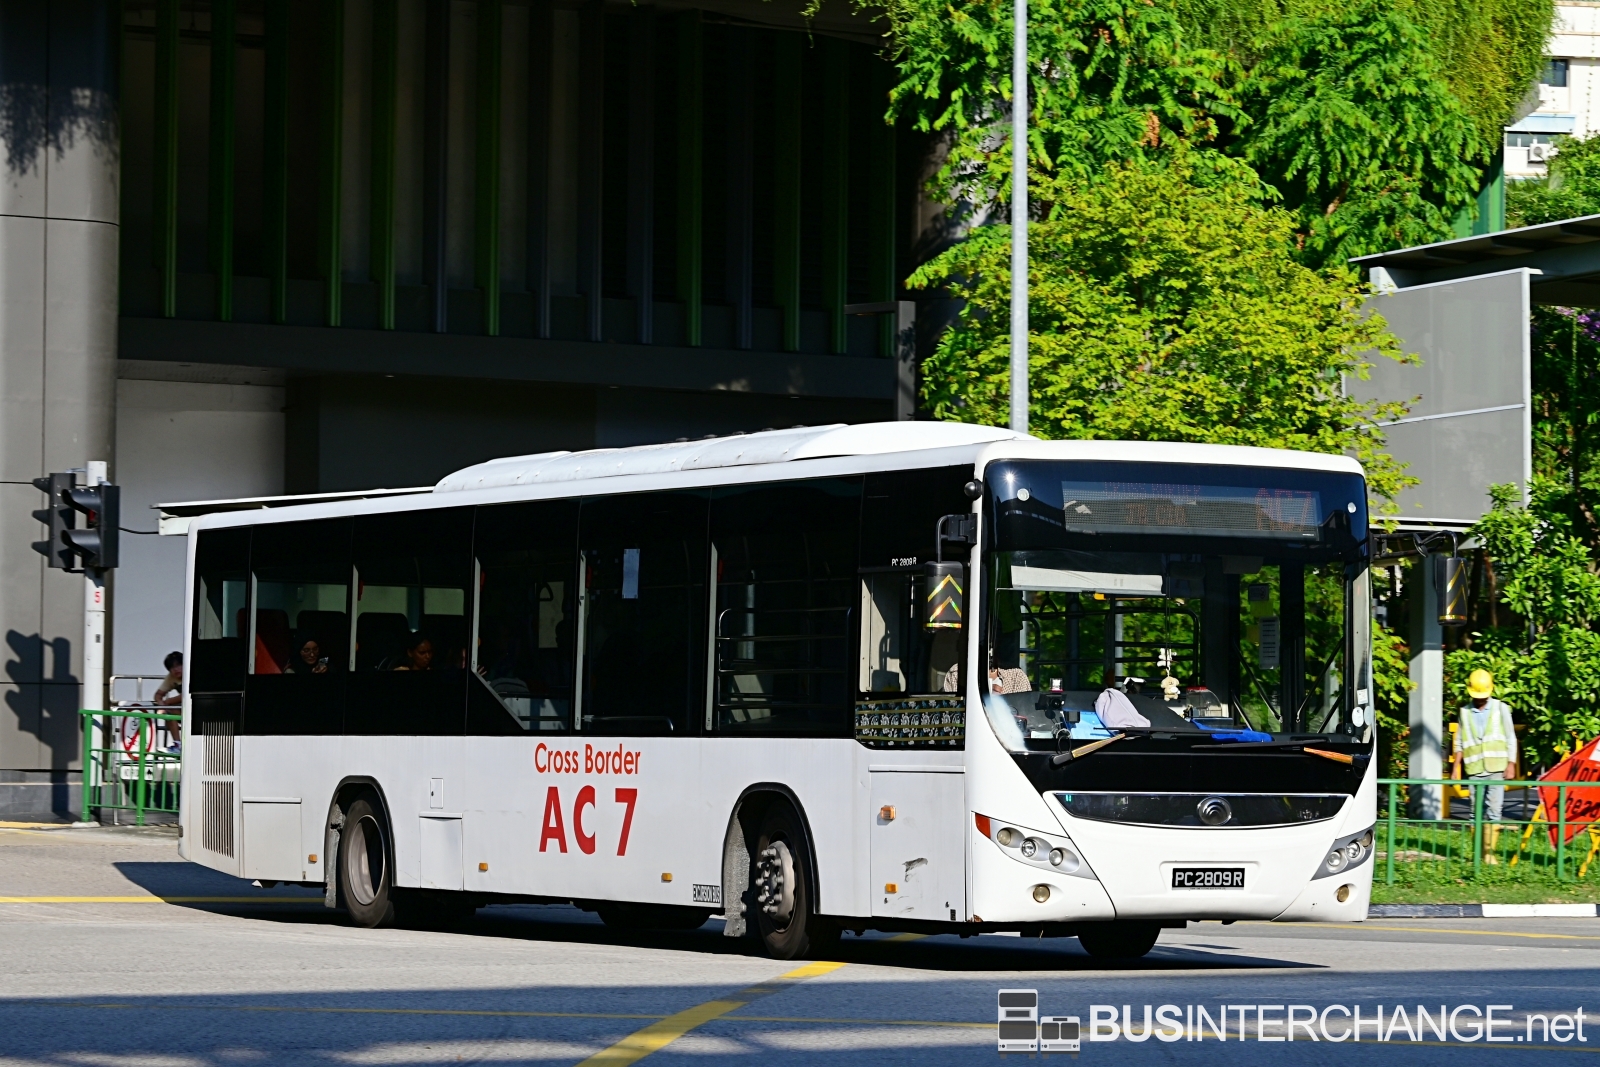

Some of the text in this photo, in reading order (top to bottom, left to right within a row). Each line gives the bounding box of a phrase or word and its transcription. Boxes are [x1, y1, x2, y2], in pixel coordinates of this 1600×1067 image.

[1254, 487, 1312, 532] AC7
[891, 558, 898, 567] PC
[899, 557, 912, 566] 2809
[94, 591, 101, 604] 5
[534, 742, 641, 775] Cross Border
[1565, 758, 1600, 783] Wor
[539, 785, 638, 857] AC 7
[1175, 871, 1243, 887] PC2809R
